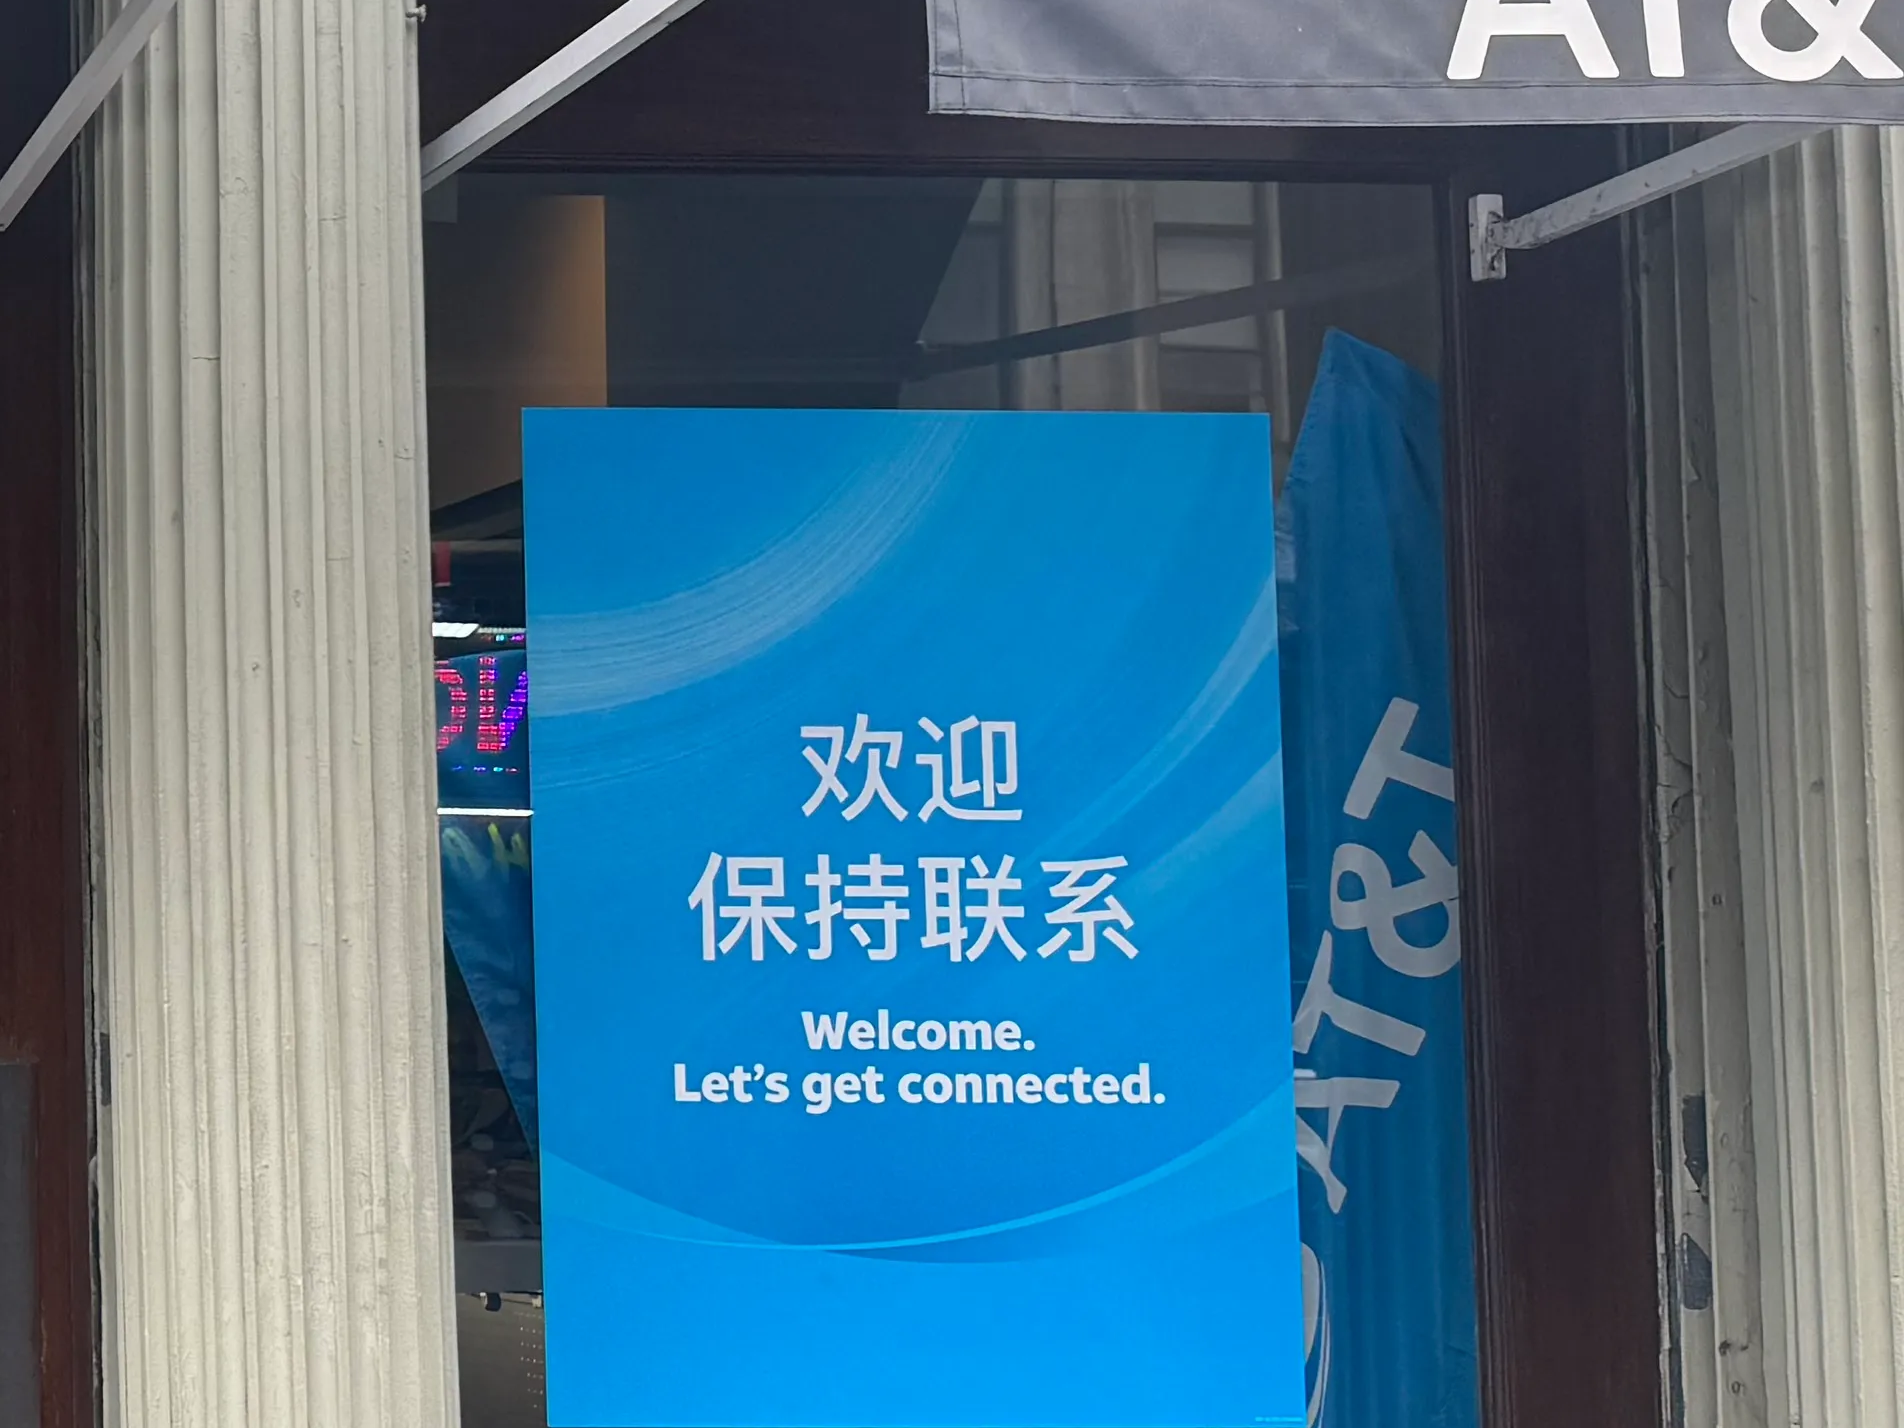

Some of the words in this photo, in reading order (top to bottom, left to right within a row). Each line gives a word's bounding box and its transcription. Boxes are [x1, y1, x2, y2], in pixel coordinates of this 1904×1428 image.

[800, 712, 1023, 823] 欢迎
[687, 851, 1139, 963] 保持联系
[801, 1009, 1035, 1051] Welcome.
[674, 1062, 790, 1104] Let’s
[802, 1065, 884, 1115] get
[898, 1062, 1165, 1105] connected.
